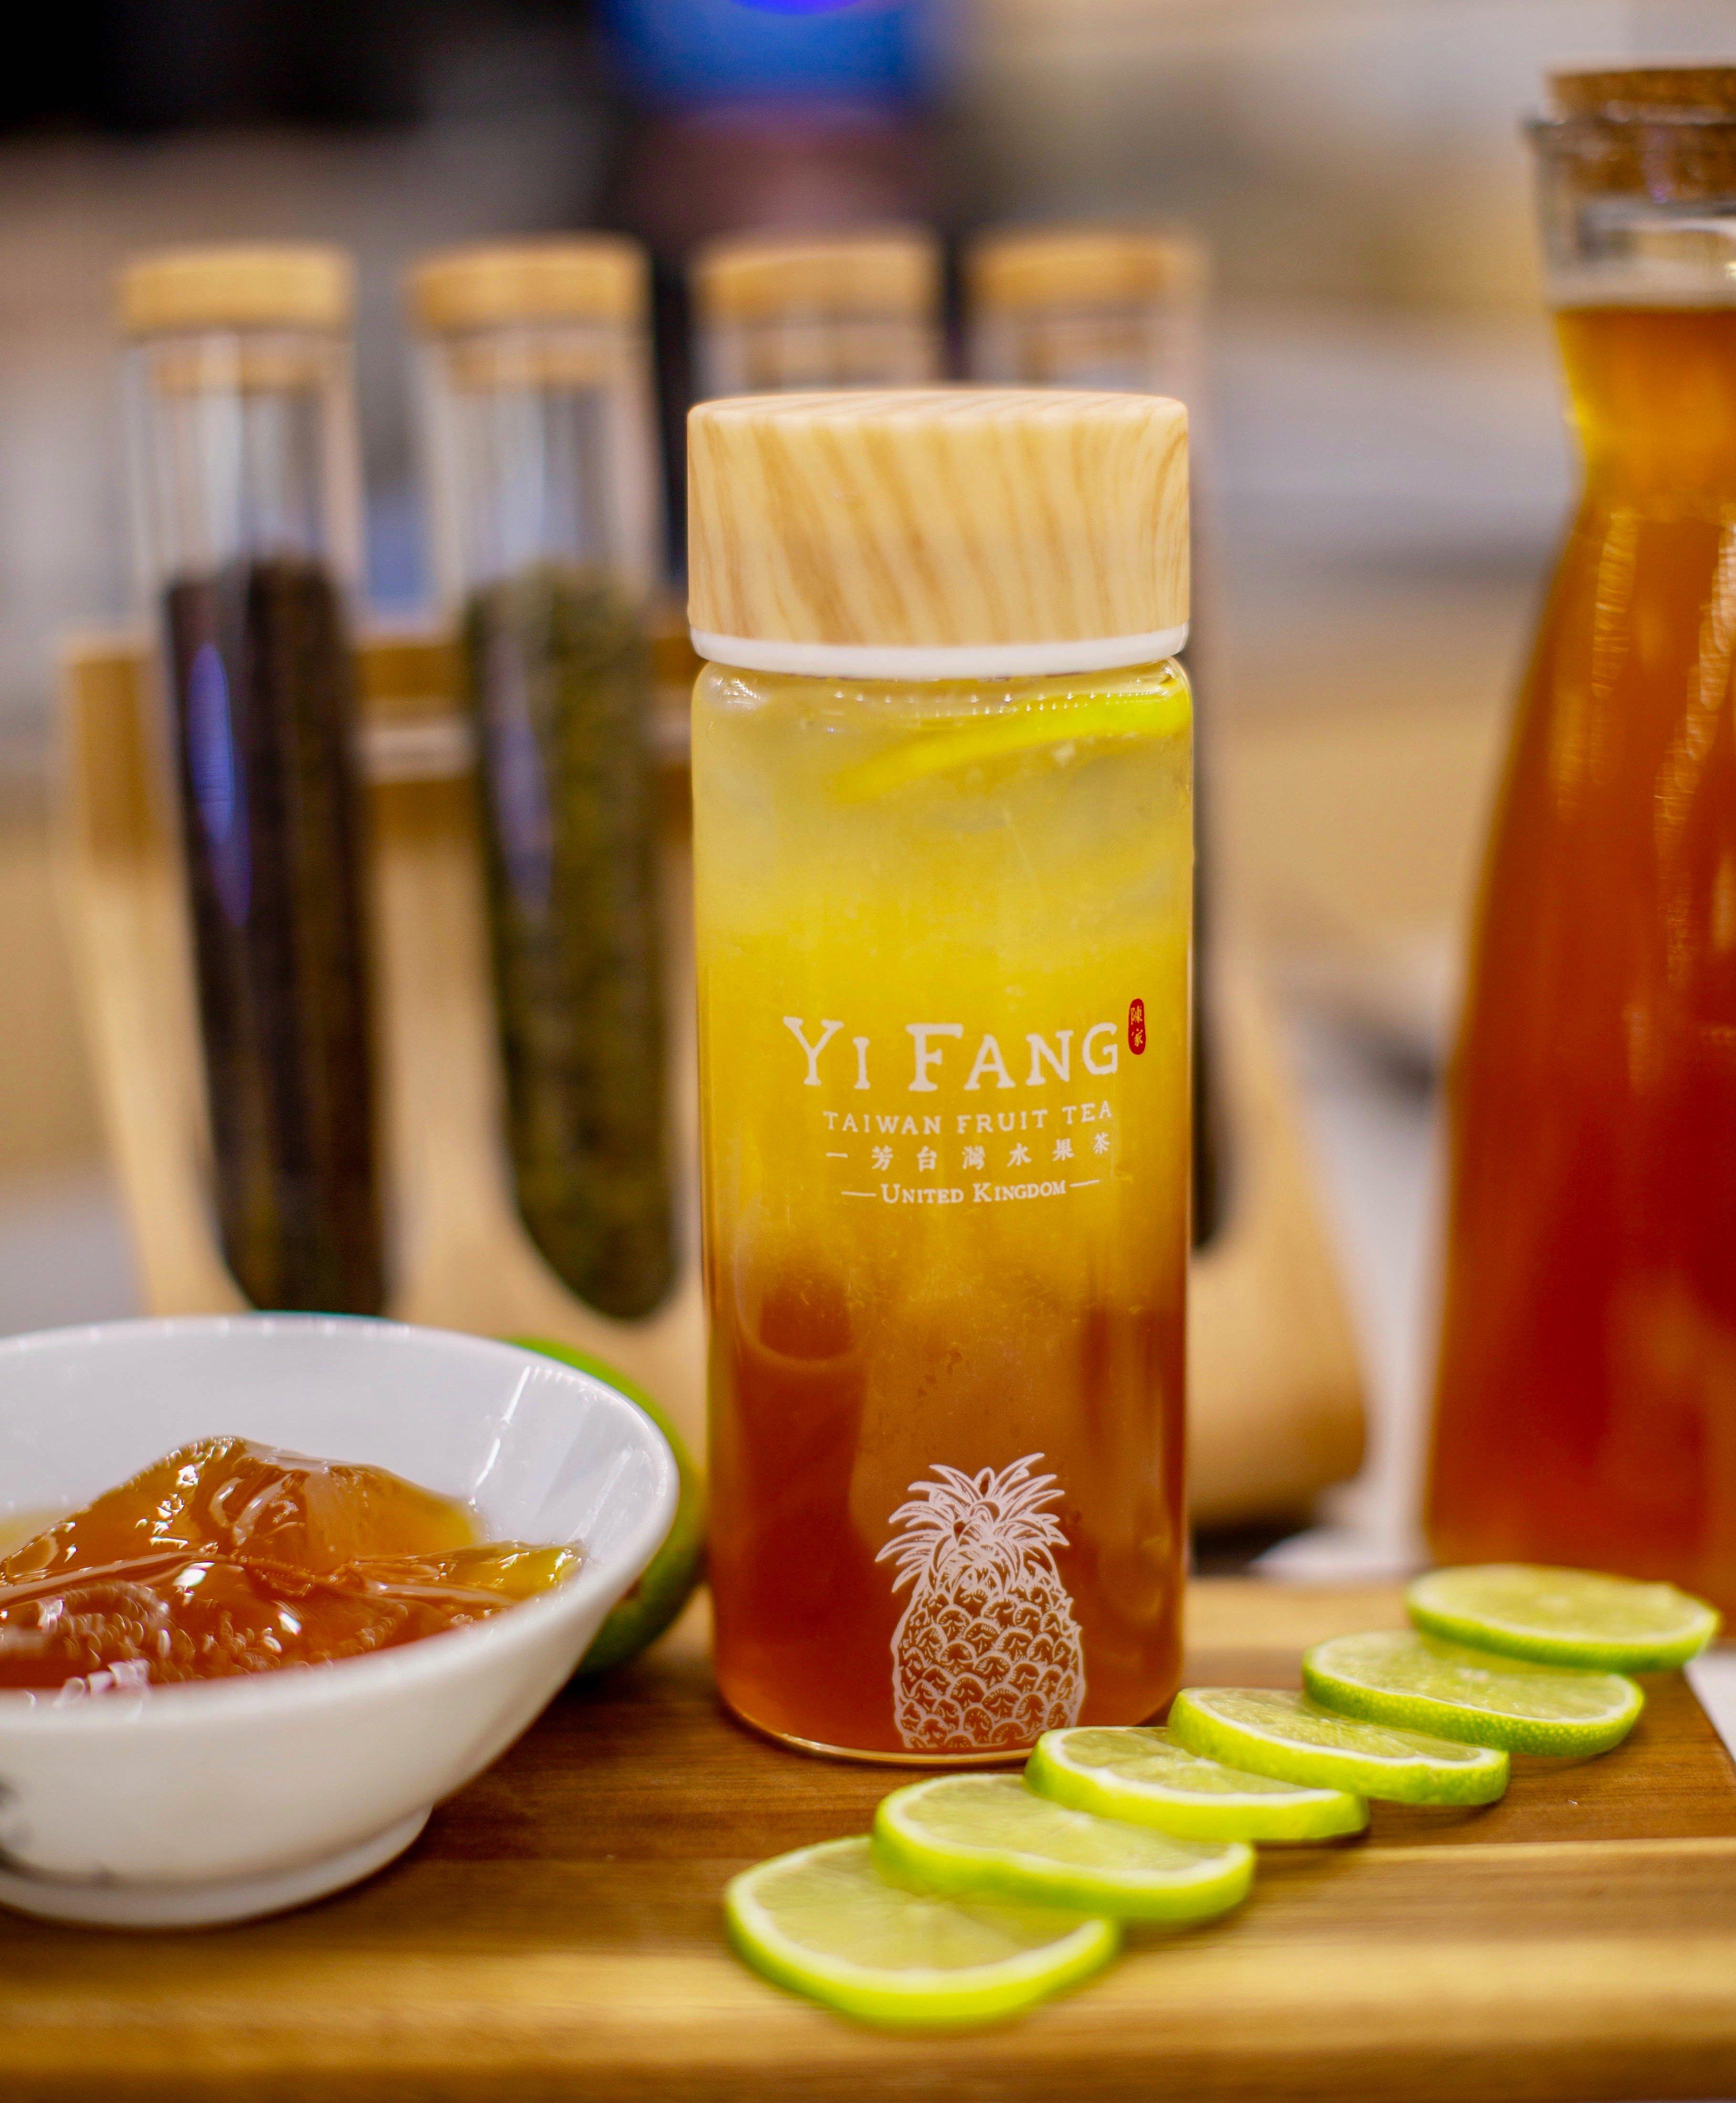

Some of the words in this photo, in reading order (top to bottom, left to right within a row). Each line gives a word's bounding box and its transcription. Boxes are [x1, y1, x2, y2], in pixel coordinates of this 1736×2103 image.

[783, 1016, 870, 1090] YI
[905, 1022, 1119, 1092] FANG
[823, 1110, 942, 1135] TAIWAN
[957, 1109, 1048, 1135] FRUIT
[1062, 1100, 1112, 1126] TEA
[880, 1183, 964, 1205] UNITED
[973, 1180, 1066, 1203] KINGDOM
